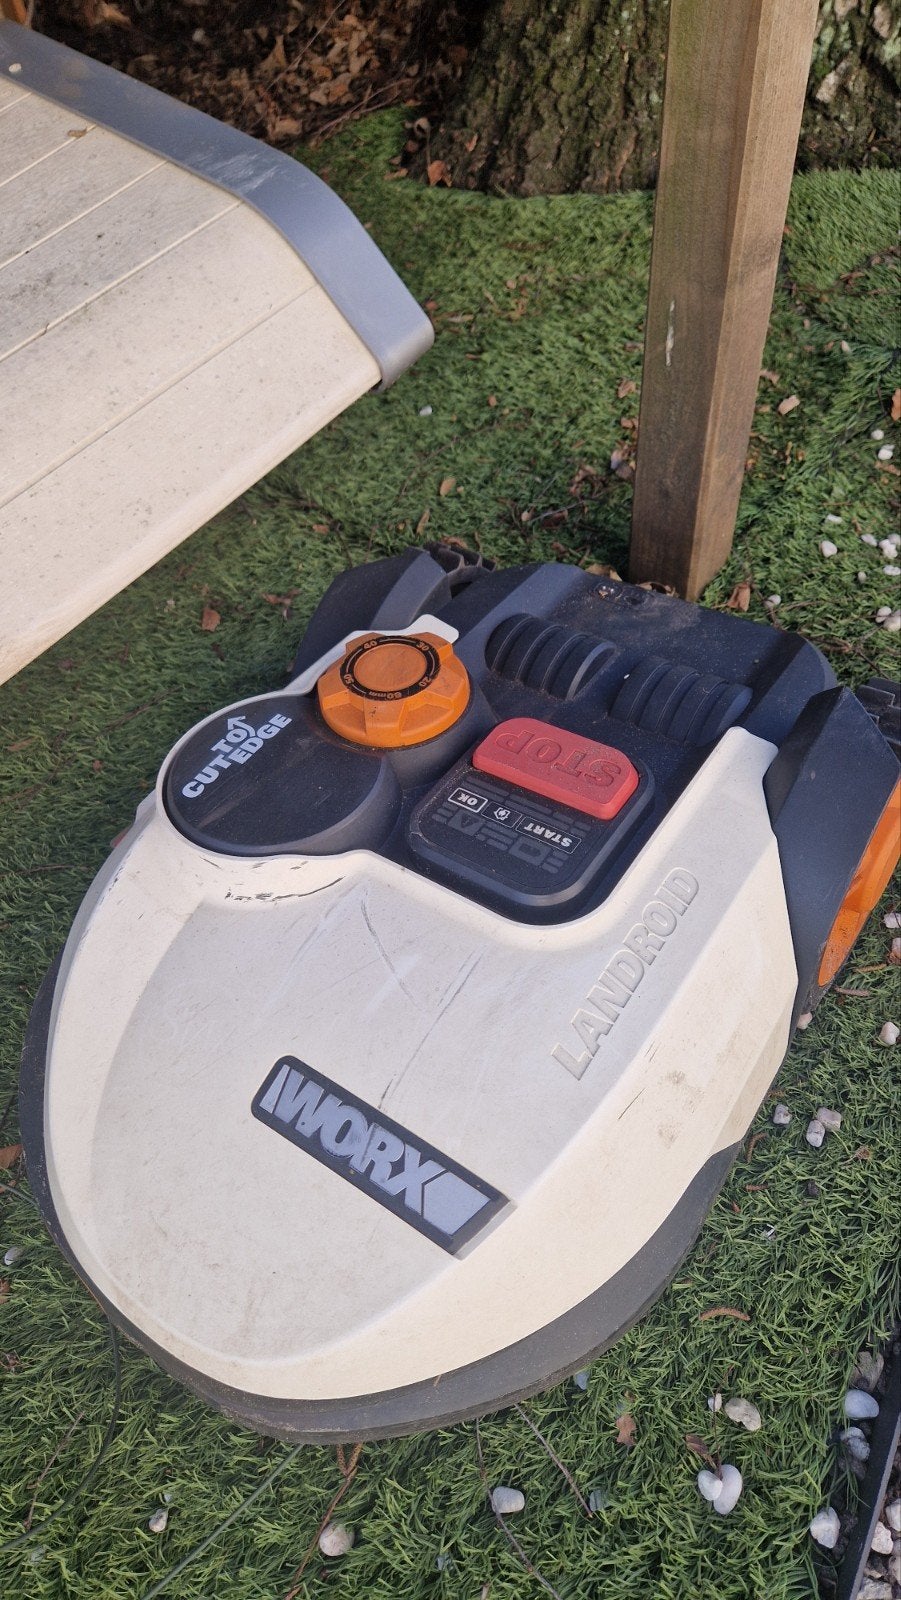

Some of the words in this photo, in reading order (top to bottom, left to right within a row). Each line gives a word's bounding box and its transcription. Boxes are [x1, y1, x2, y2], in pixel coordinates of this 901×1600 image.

[416, 640, 430, 651] 30
[344, 674, 354, 685] 50
[419, 676, 432, 687] 20
[182, 754, 232, 798] CUT
[210, 728, 248, 753] TO
[229, 713, 293, 765] EDGE
[496, 729, 622, 787] STOP
[458, 792, 478, 807] OK
[524, 822, 573, 848] START
[551, 867, 699, 1081] LANDROID
[260, 1064, 448, 1216] WORX
